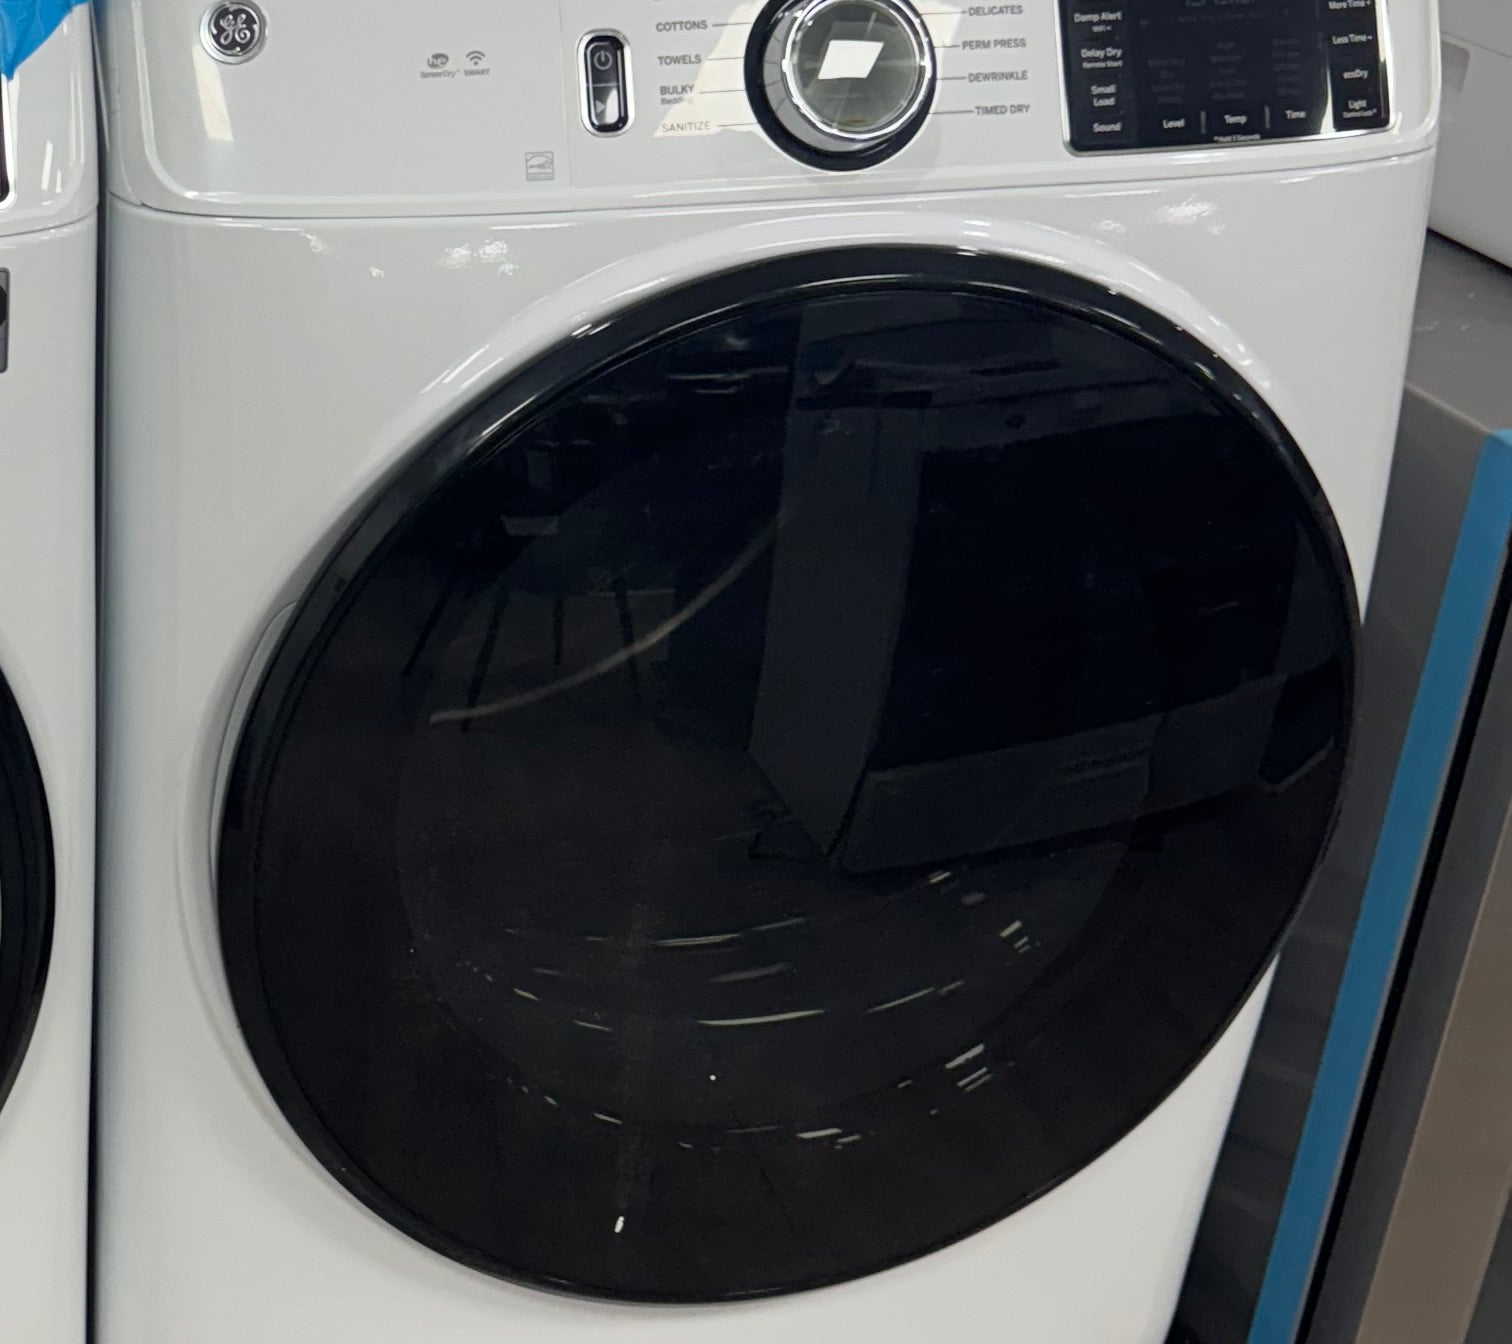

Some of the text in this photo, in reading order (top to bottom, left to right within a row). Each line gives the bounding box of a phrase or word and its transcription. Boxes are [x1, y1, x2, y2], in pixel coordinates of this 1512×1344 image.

[968, 5, 1024, 17] DELICATES
[1328, 0, 1347, 10] More
[1100, 11, 1122, 21] Alert
[656, 20, 708, 32] COTTONS
[962, 38, 1027, 51] PERM PRESS
[1349, 34, 1367, 43] Time
[1080, 47, 1123, 59] Delay Dry
[658, 54, 702, 66] TOWELS
[968, 70, 1029, 83] DEWRINKLE
[659, 84, 695, 96] BULKY
[1090, 84, 1117, 95] Small
[1093, 97, 1116, 107] Load
[975, 104, 1031, 116] TIMED DRY
[1285, 109, 1307, 120] Time
[1162, 118, 1186, 129] Level
[1224, 114, 1248, 125] Temp
[662, 121, 710, 133] SANITIZE
[1092, 121, 1122, 133] Sound
